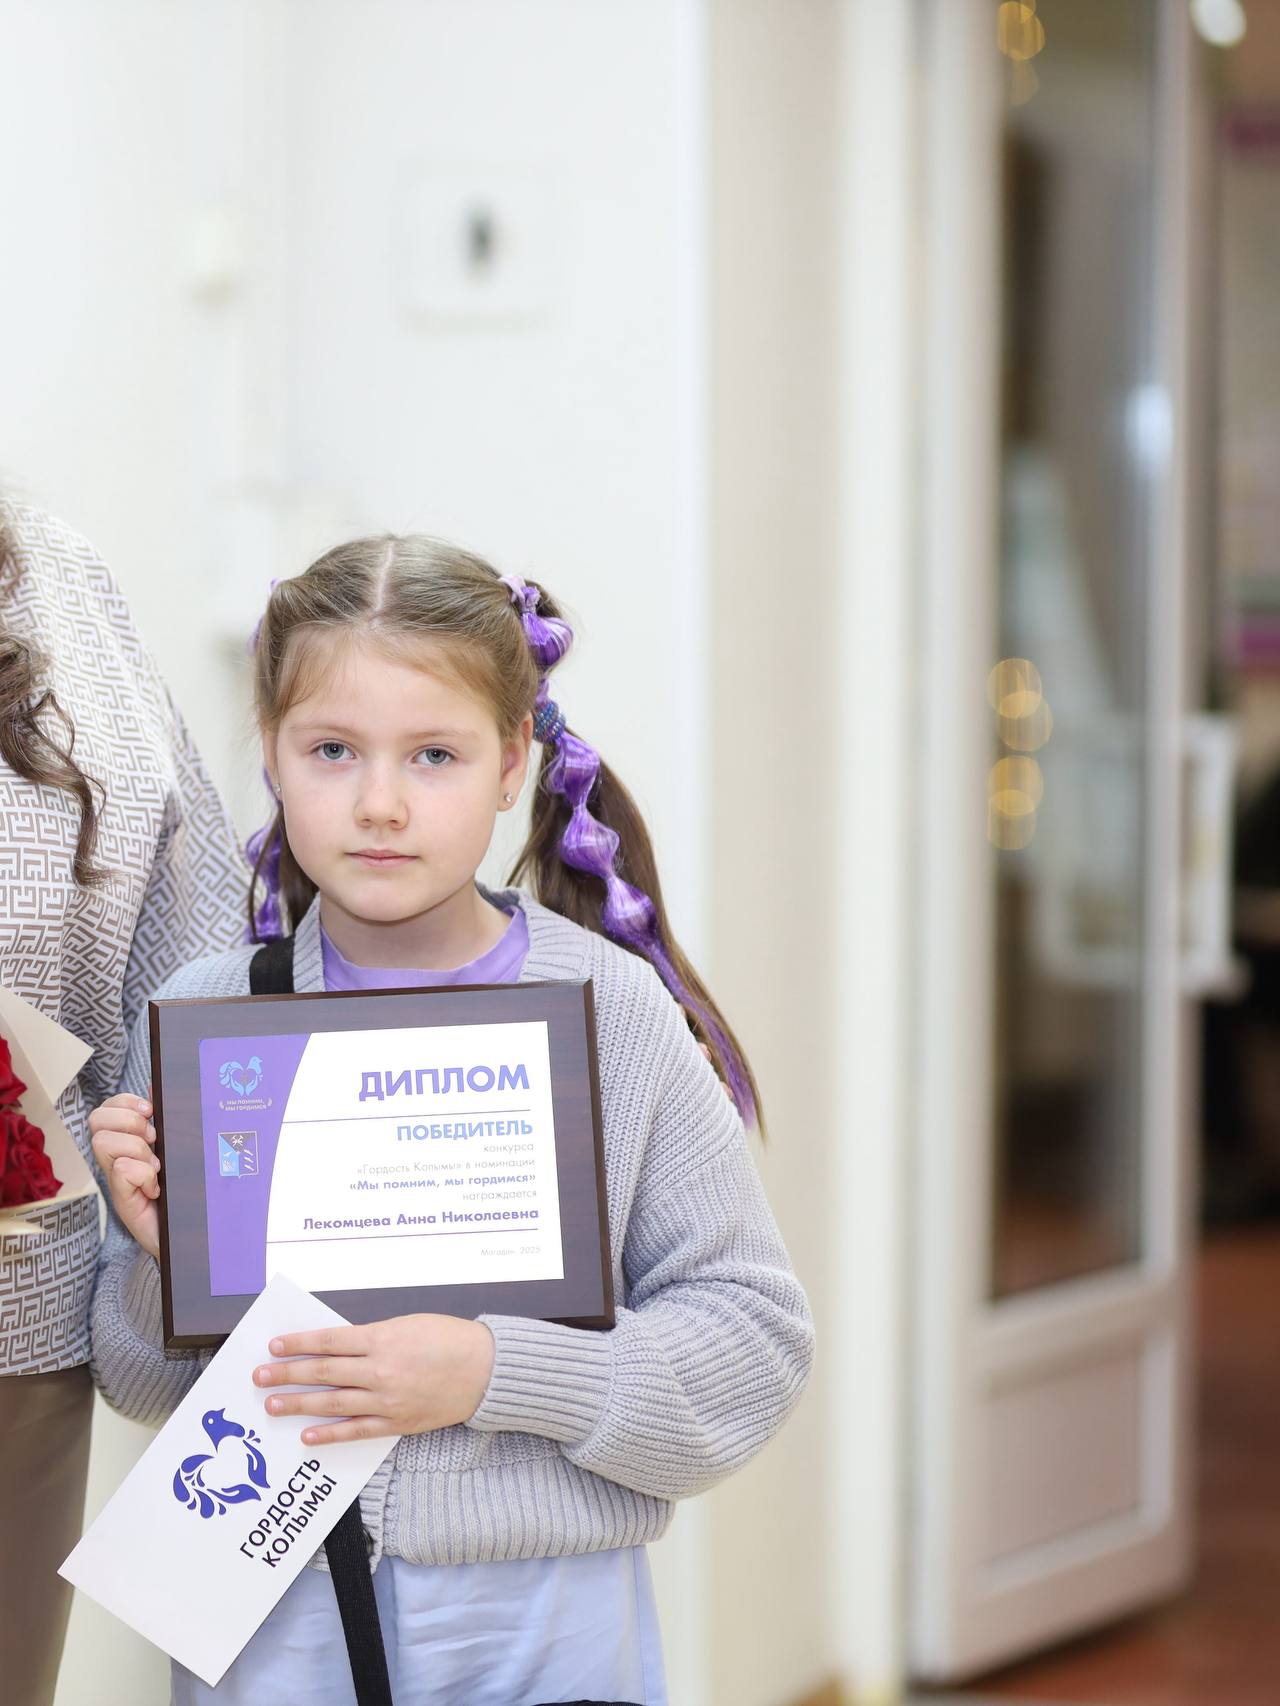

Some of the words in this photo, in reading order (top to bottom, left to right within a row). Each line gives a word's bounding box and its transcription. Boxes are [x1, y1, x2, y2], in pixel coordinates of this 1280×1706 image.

[358, 1063, 531, 1101] ДИПЛОМ
[396, 1119, 534, 1141] ПОБЕДИТЕЛЬ
[483, 1143, 534, 1154] конкурса
[357, 1164, 410, 1175] «Гордость
[465, 1162, 471, 1170] в
[474, 1159, 535, 1170] номинации
[350, 1180, 379, 1191] «Мы
[383, 1178, 440, 1190] помним,
[444, 1177, 464, 1186] мы
[468, 1174, 536, 1187] гордимся»
[462, 1190, 537, 1202] награждается
[303, 1216, 391, 1230] Лекомцева
[396, 1213, 437, 1225] Анна
[442, 1208, 539, 1223] Николаевна
[239, 1456, 321, 1559] ГОРДОСТЬ
[261, 1474, 338, 1568] КОЛЫМЫ
